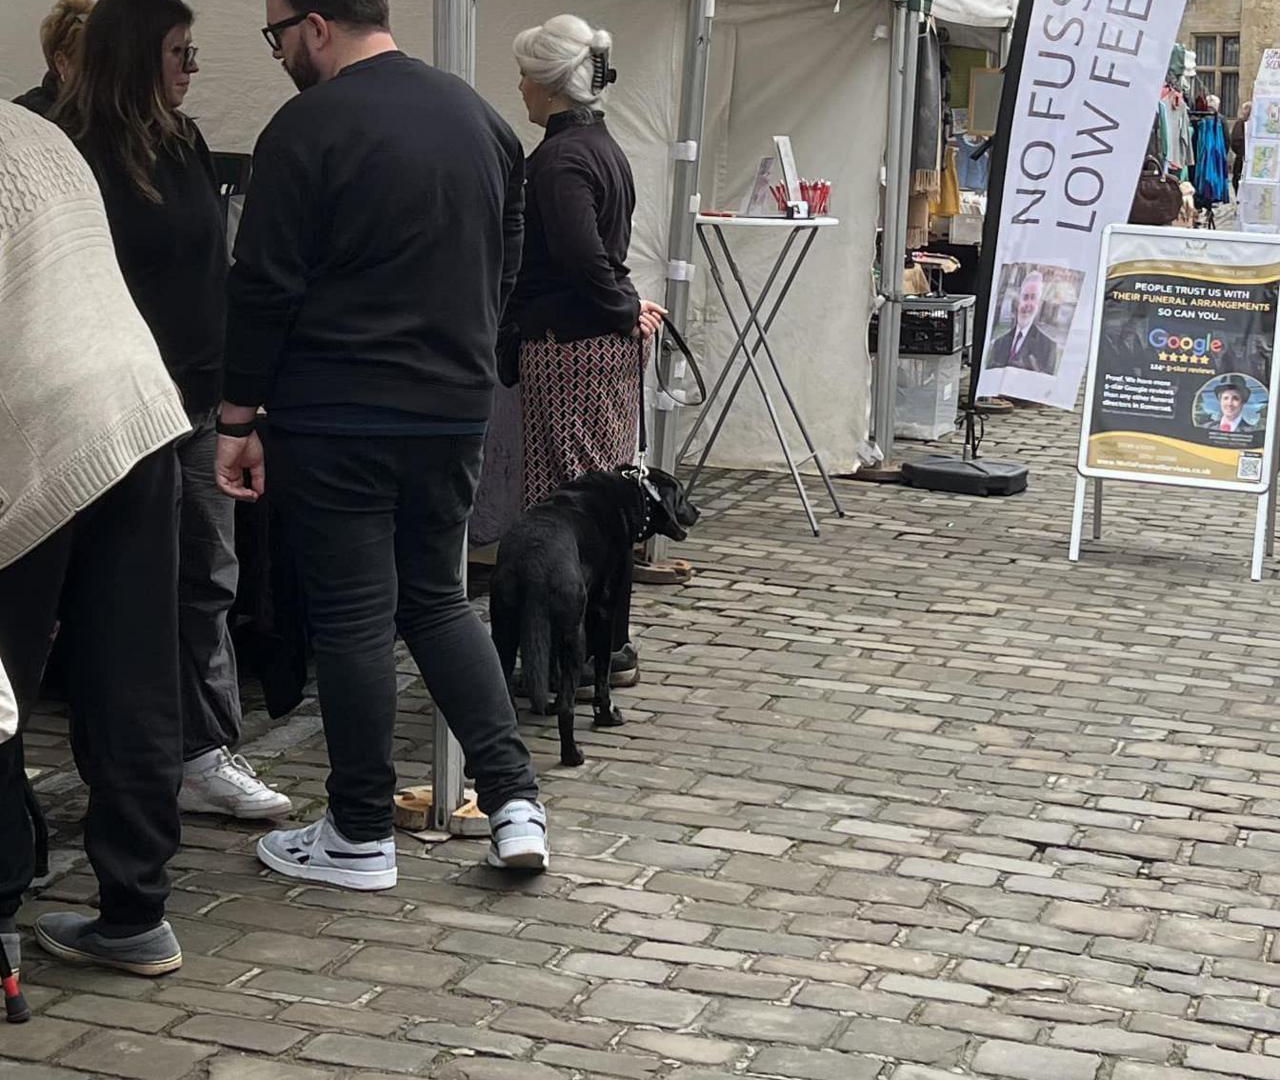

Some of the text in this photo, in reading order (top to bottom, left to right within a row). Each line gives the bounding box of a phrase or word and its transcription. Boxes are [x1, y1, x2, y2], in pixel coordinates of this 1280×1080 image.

[1056, 100, 1120, 233] LOW
[1011, 140, 1056, 225] NO
[1112, 291, 1271, 312] THEIR FUNERAL ARRANGEMENTS
[1135, 282, 1250, 299] PEOPLE TRUST US WITH
[1157, 307, 1171, 317] SO
[1173, 309, 1195, 319] CAN
[1149, 328, 1223, 356] Google
